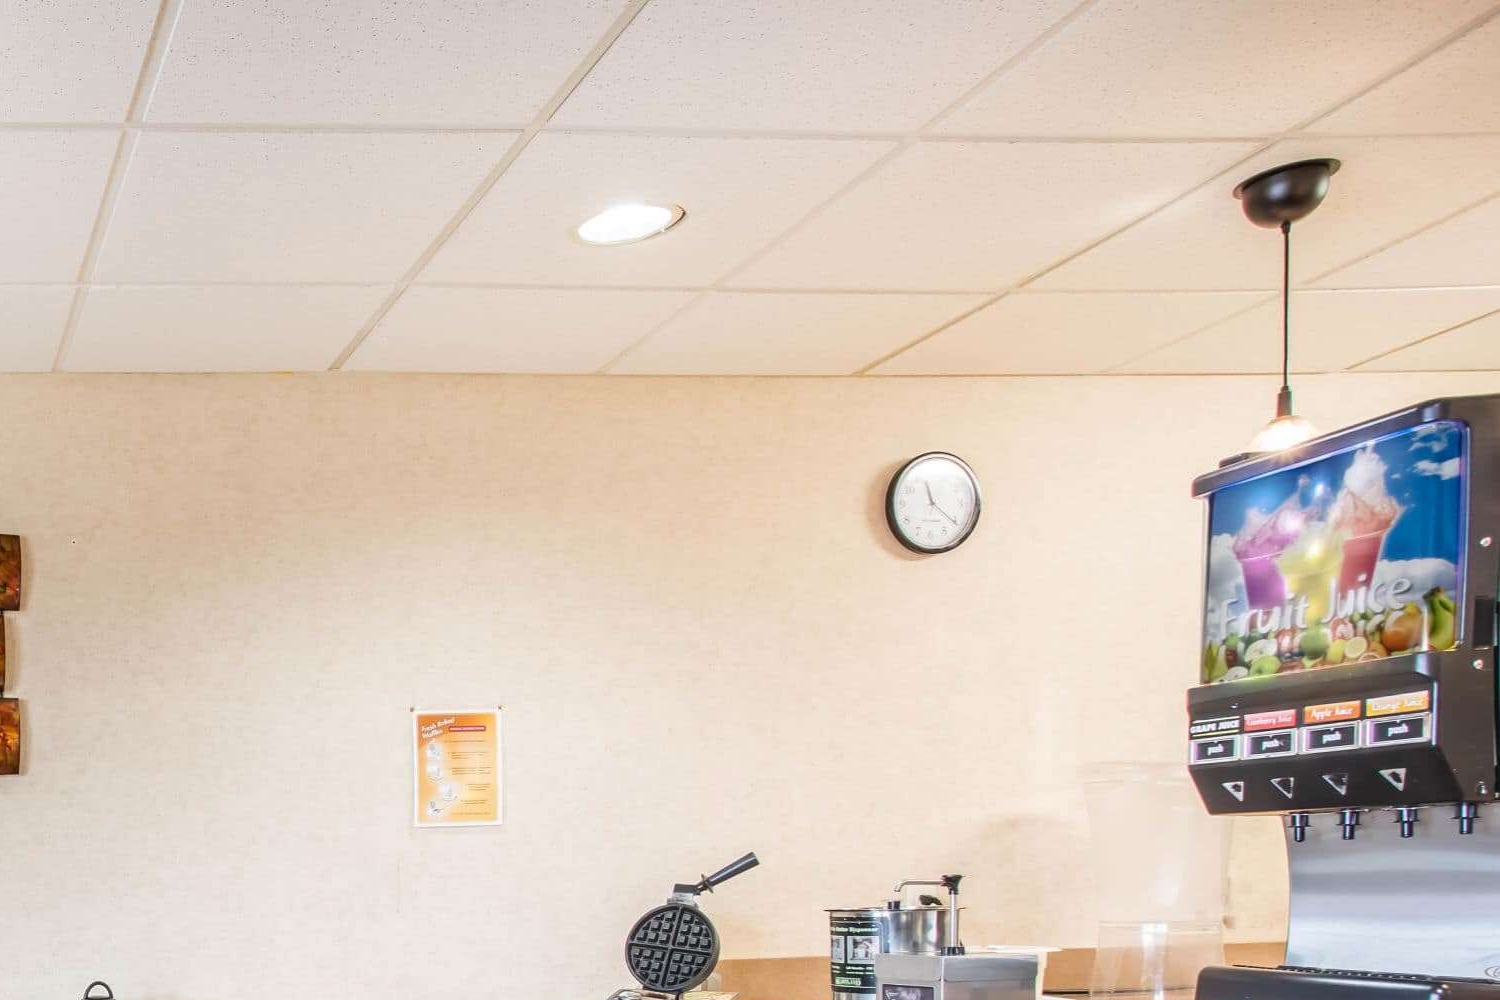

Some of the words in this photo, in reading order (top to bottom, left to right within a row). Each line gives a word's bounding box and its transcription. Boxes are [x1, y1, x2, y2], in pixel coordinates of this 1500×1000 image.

[1220, 592, 1310, 636] Fruit
[1321, 572, 1413, 624] Juice
[1190, 722, 1217, 734] GRAPE
[1218, 719, 1240, 730] JUICE
